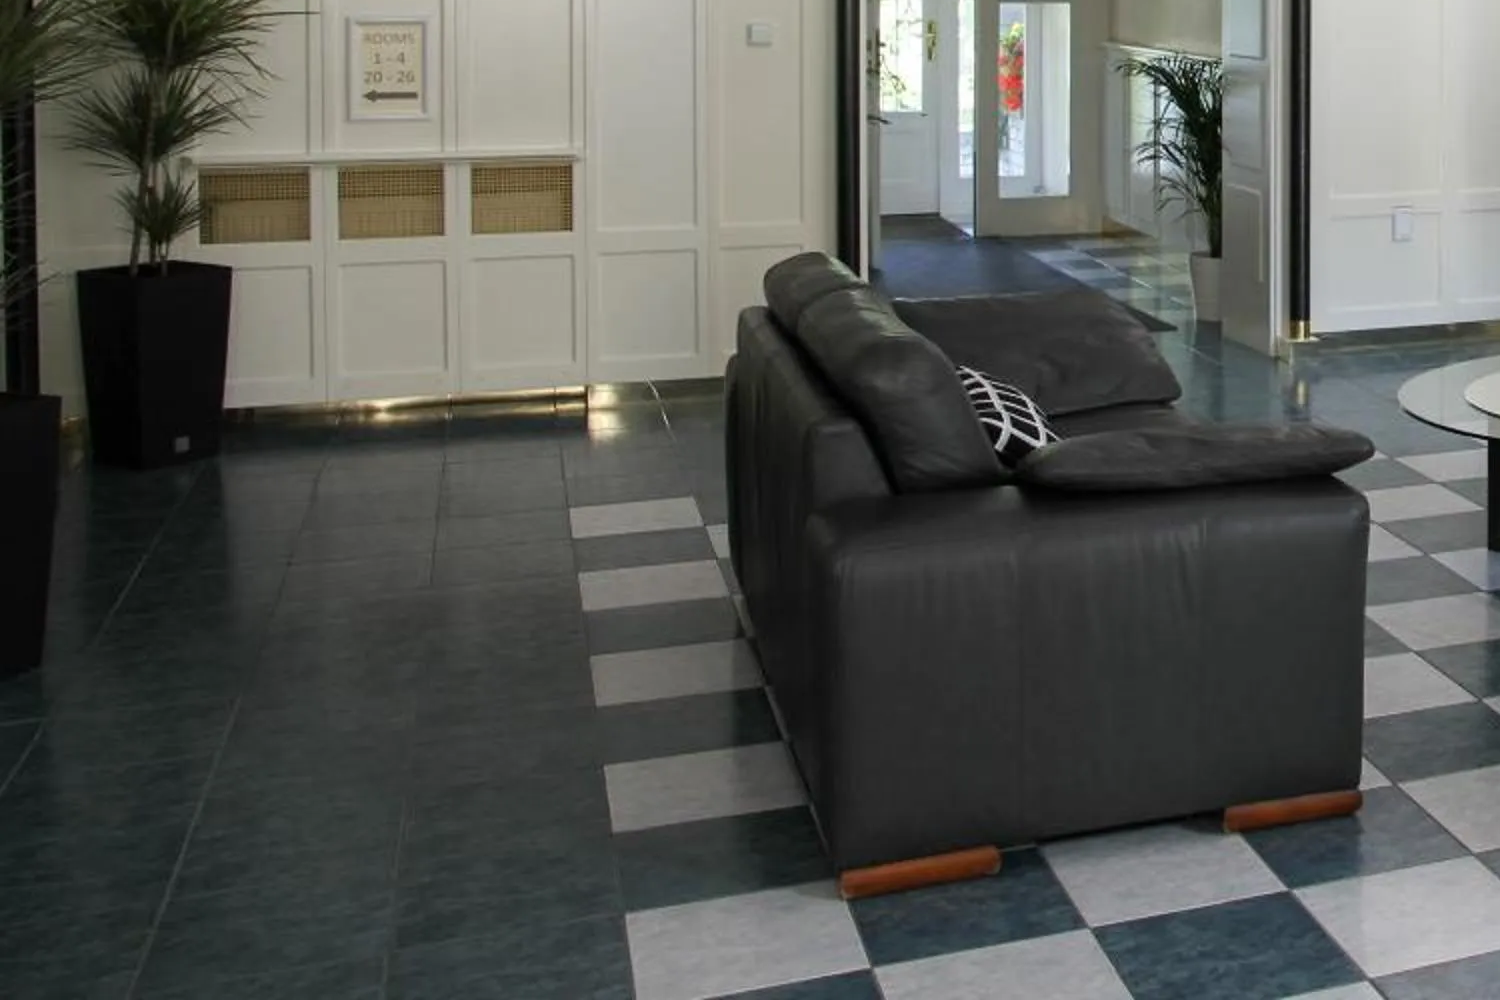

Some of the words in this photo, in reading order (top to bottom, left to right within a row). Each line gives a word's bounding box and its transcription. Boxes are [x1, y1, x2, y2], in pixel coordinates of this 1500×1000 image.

[363, 32, 415, 45] ROOMS
[396, 52, 405, 65] 4
[363, 70, 383, 84] 20
